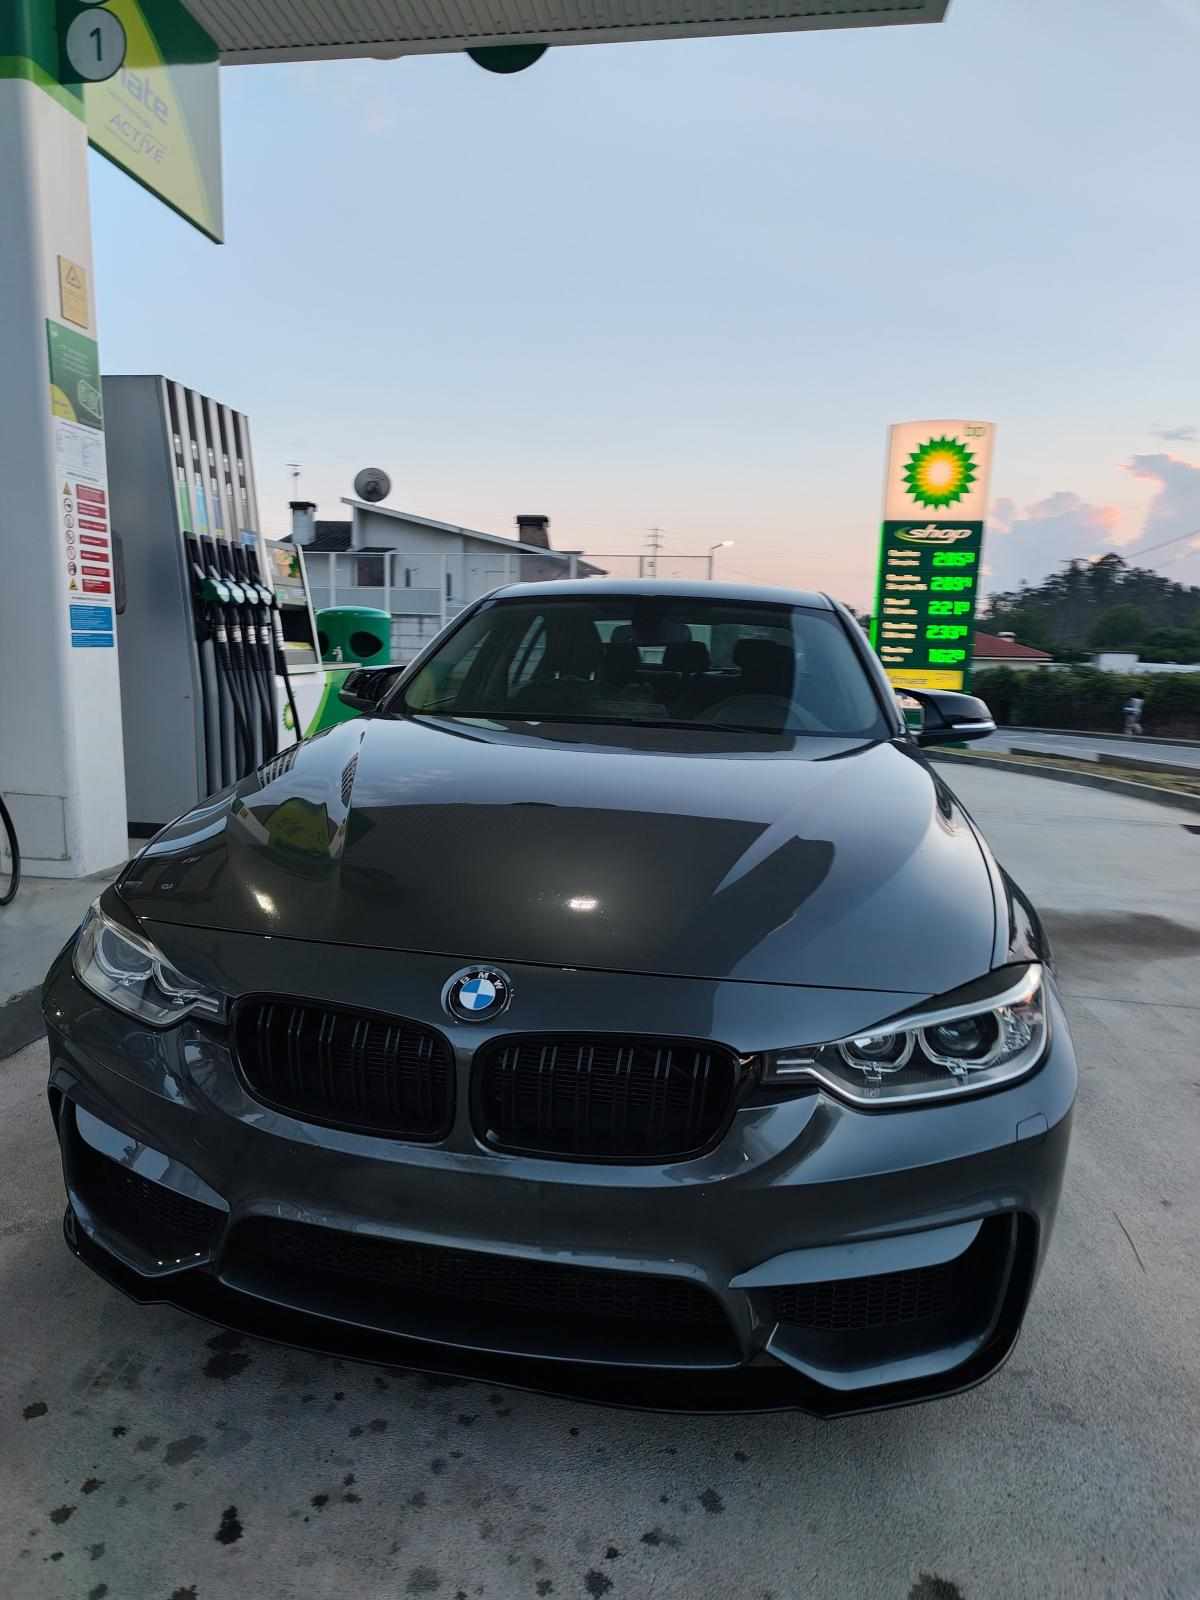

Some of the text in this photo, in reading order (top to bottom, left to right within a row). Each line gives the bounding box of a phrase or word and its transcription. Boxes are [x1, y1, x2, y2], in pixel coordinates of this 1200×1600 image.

[89, 27, 103, 62] 1
[110, 113, 167, 164] ACTIVE
[908, 523, 973, 544] shop
[460, 971, 504, 990] BMW
